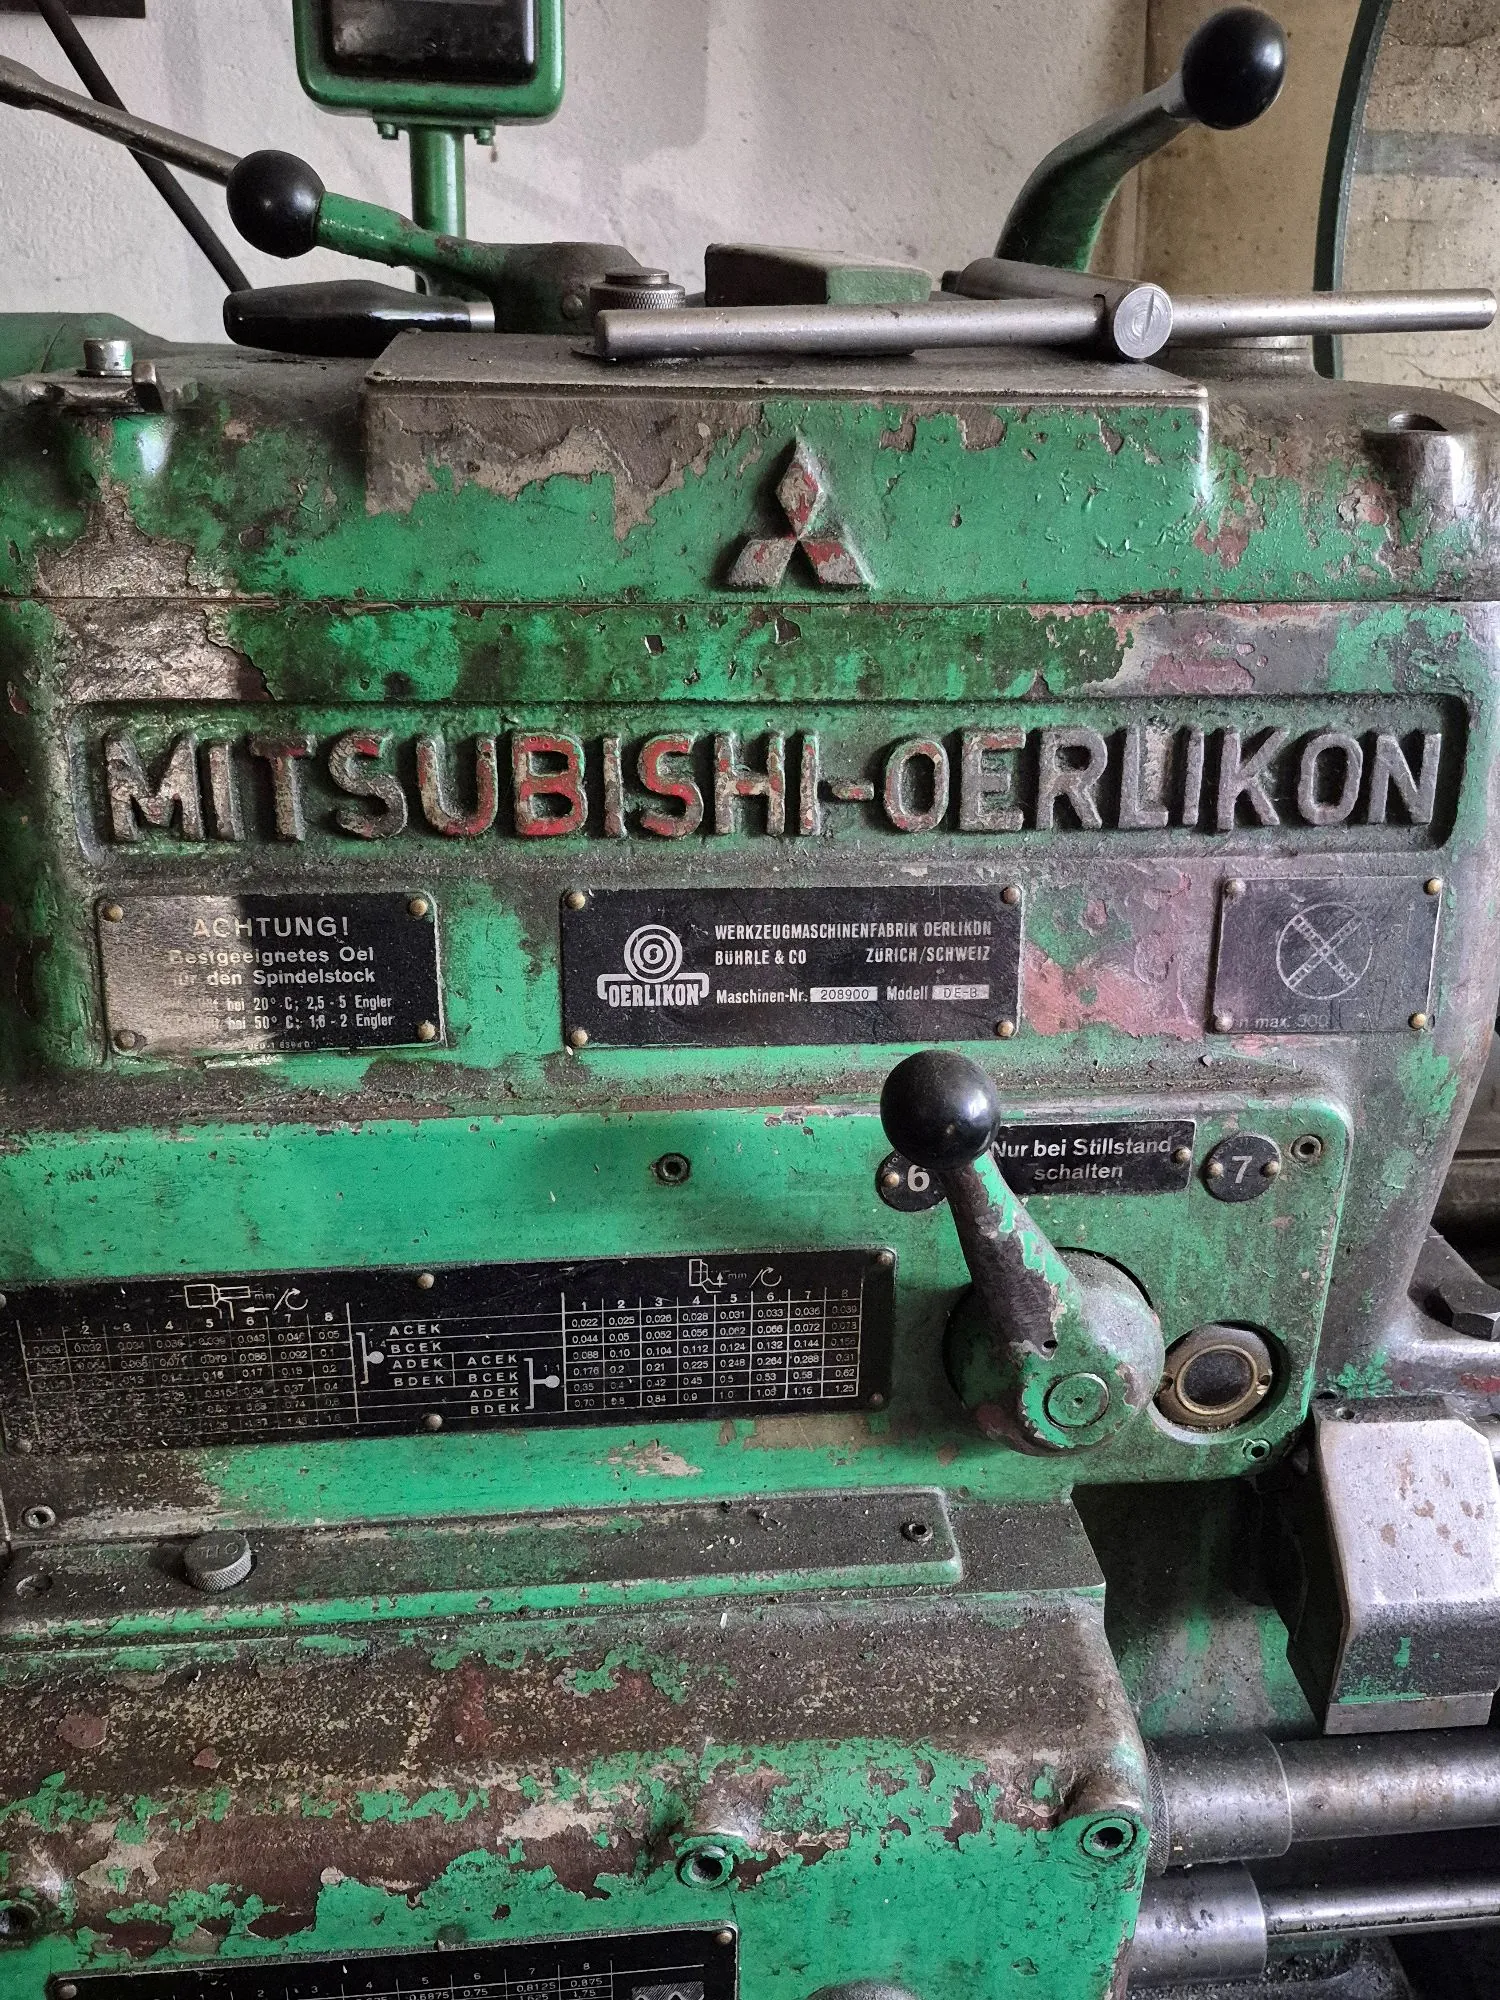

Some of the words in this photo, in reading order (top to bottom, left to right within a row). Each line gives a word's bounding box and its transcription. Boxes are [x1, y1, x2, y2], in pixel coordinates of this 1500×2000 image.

[104, 728, 1443, 843] MITSUBISHI-OERLIKON
[192, 916, 349, 938] ACHTUNG!
[714, 922, 918, 940] WERKZEUGMASCHINENFABRIK
[924, 920, 992, 937] OERLIKON
[339, 947, 374, 961] Oel
[715, 950, 770, 965] BÜHRLE
[774, 950, 784, 964] &
[788, 950, 806, 964] CO
[866, 946, 990, 964] ZÜRICH/SCHWEIZ
[207, 971, 242, 985] den
[253, 969, 375, 988] Spindelstock
[253, 997, 276, 1011] 20°
[307, 996, 324, 1011] 2,5
[339, 995, 346, 1008] 5
[355, 995, 392, 1010] Engler
[608, 984, 699, 1007] OERLIKON
[716, 989, 808, 1004] Maschinen-Nr.
[820, 990, 869, 1000] 208900
[887, 986, 928, 1000] Modell
[255, 1015, 277, 1029] 50°
[341, 1014, 347, 1027] 2
[356, 1013, 393, 1030] Engler
[991, 1141, 1028, 1158] Nur
[1033, 1139, 1067, 1157] bei
[1073, 1136, 1172, 1155] Stillstand
[908, 1164, 930, 1192] 6
[1034, 1164, 1123, 1180] schalten
[1232, 1156, 1252, 1183] 7
[582, 1302, 586, 1310] 1
[618, 1300, 625, 1308] 2
[655, 1297, 663, 1306] 3
[692, 1296, 700, 1304] 4
[730, 1294, 737, 1302] 5
[767, 1292, 774, 1301] 6
[805, 1291, 811, 1299] 7
[842, 1290, 848, 1298] 8
[82, 1325, 90, 1334] 2
[123, 1323, 131, 1332] 3
[165, 1321, 173, 1329] 4
[206, 1319, 213, 1328] 5
[246, 1317, 254, 1325] 6
[285, 1314, 291, 1323] 7
[325, 1312, 333, 1321] 8
